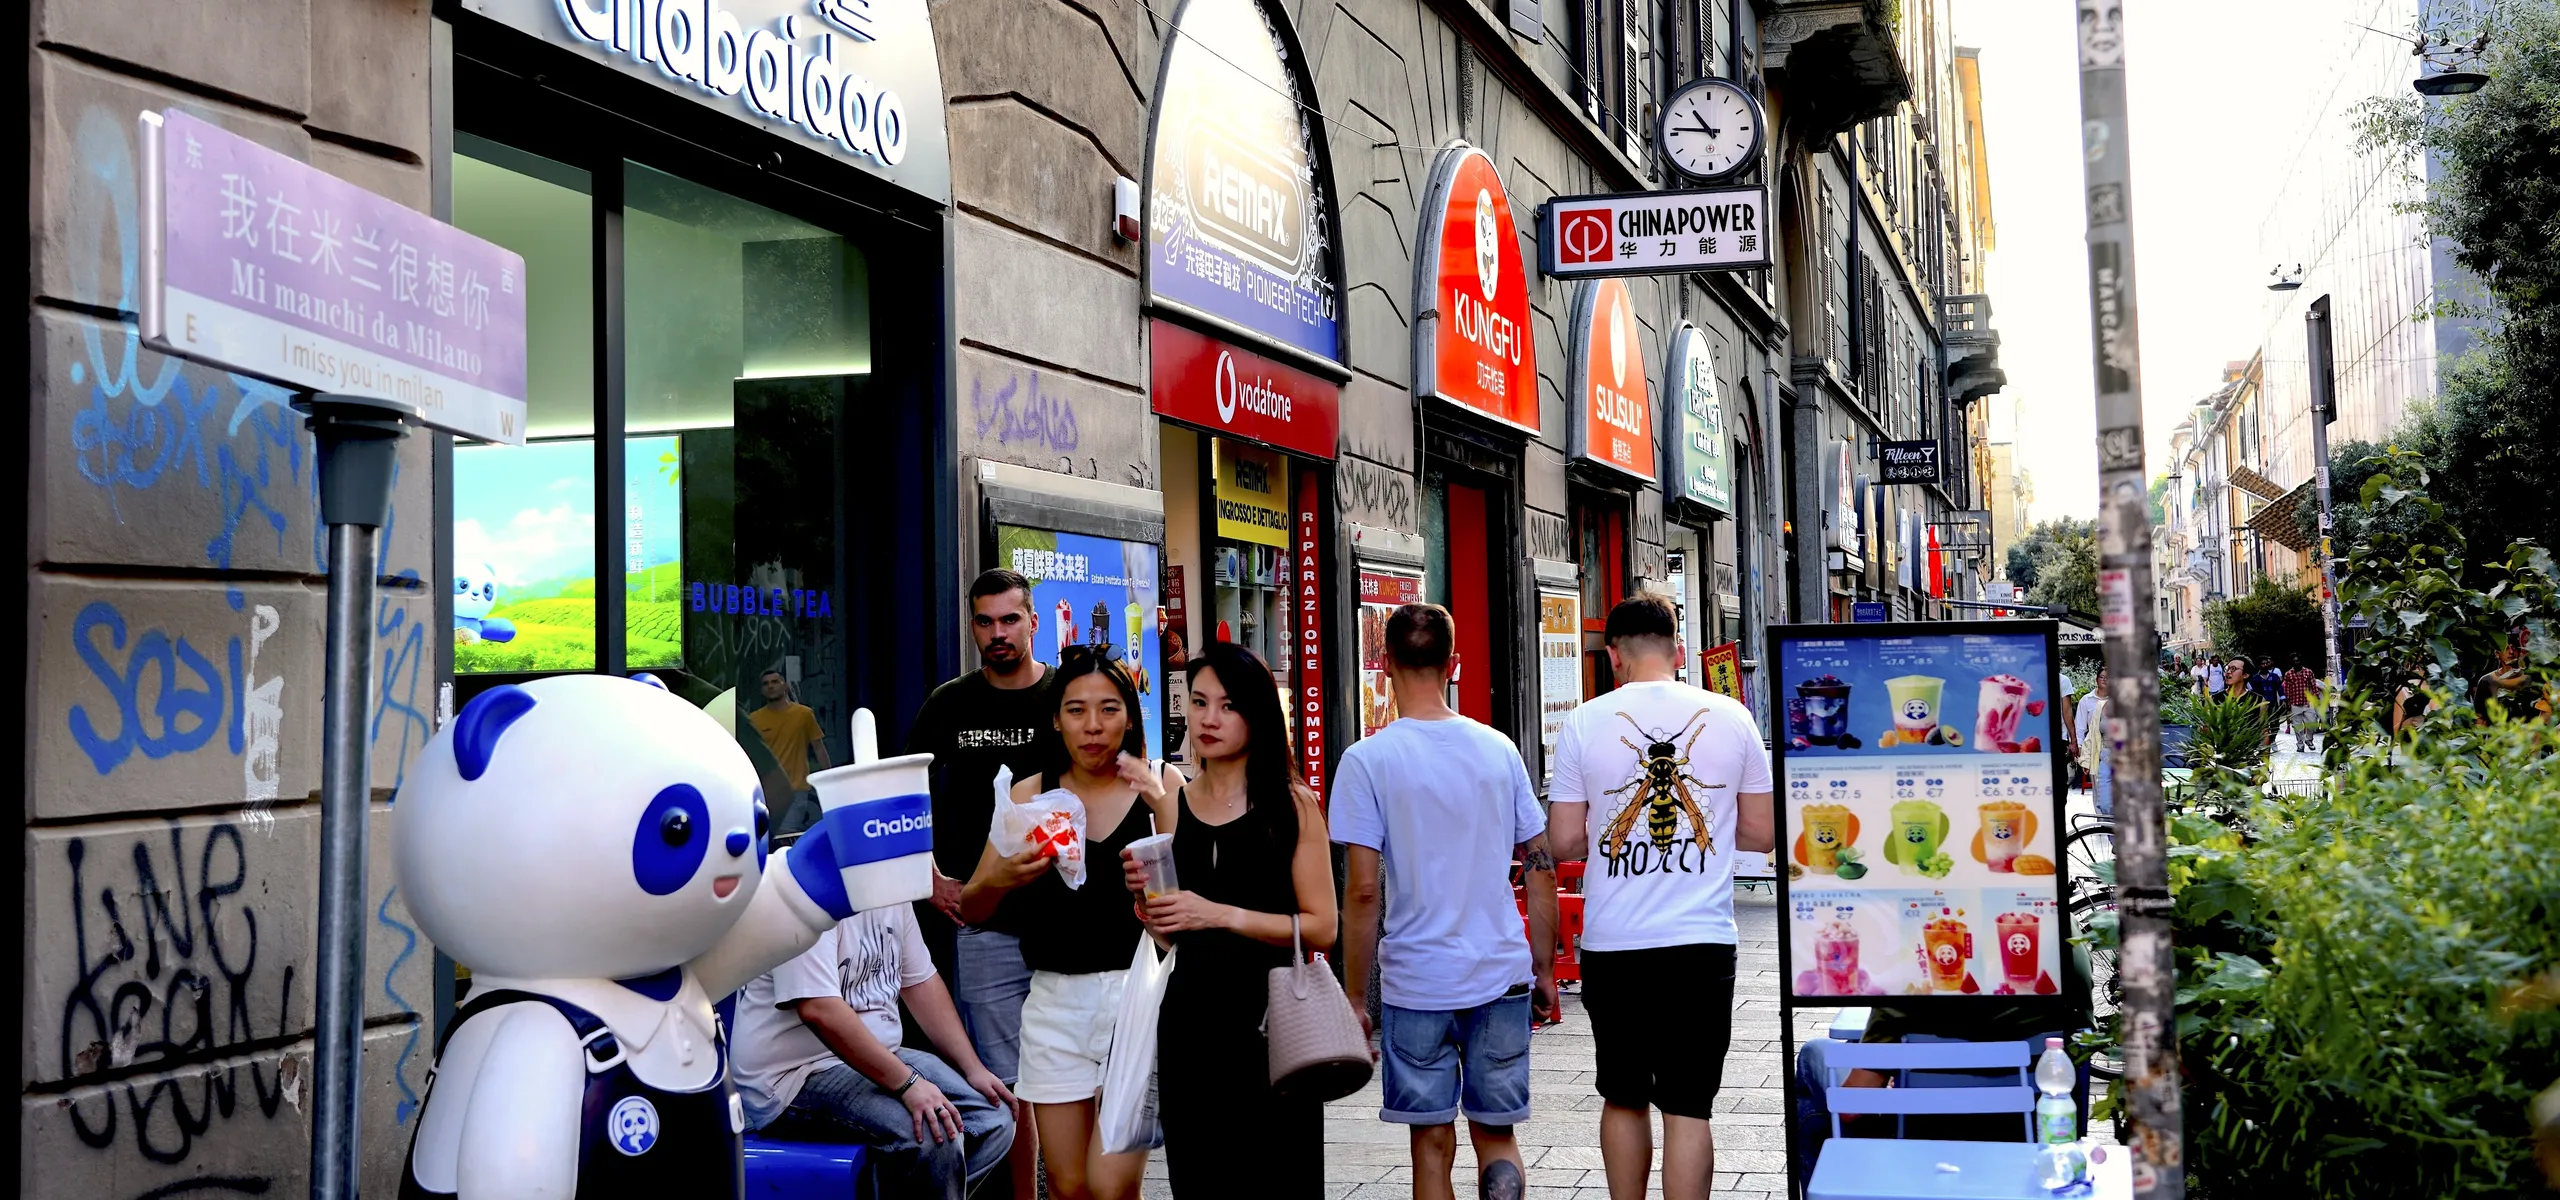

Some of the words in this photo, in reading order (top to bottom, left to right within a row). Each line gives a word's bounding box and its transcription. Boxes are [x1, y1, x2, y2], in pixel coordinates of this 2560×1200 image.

[185, 137, 203, 169] 东
[1202, 150, 1287, 247] REMAX
[1618, 204, 1756, 238] CHINAPOWER
[219, 173, 490, 331] 我在米兰很想你
[1619, 234, 1757, 259] 华力能源
[500, 268, 514, 294] 西
[231, 257, 266, 305] Mi
[274, 280, 366, 339] manchi
[372, 310, 399, 350] da
[406, 320, 483, 377] Milano
[1294, 291, 1321, 327] TECH
[1454, 287, 1521, 366] KUNGFU
[185, 313, 198, 344] E
[293, 342, 336, 378] miss
[339, 354, 372, 388] you
[376, 364, 392, 393] in
[396, 370, 444, 411] milan
[1238, 376, 1293, 422] vodafone
[1595, 383, 1643, 437] SULISULI
[500, 410, 514, 438] W
[1884, 447, 1922, 465] Fifteen
[1885, 465, 1935, 479] 美味小吃
[1234, 458, 1270, 494] REMAX
[1218, 498, 1252, 525] INGROSSO
[1252, 506, 1258, 526] E
[1257, 506, 1288, 531] DETTAGLIO
[692, 582, 783, 616] BUBBLE
[792, 588, 832, 618] TEA
[1301, 512, 1319, 670] RIPARAZIONE
